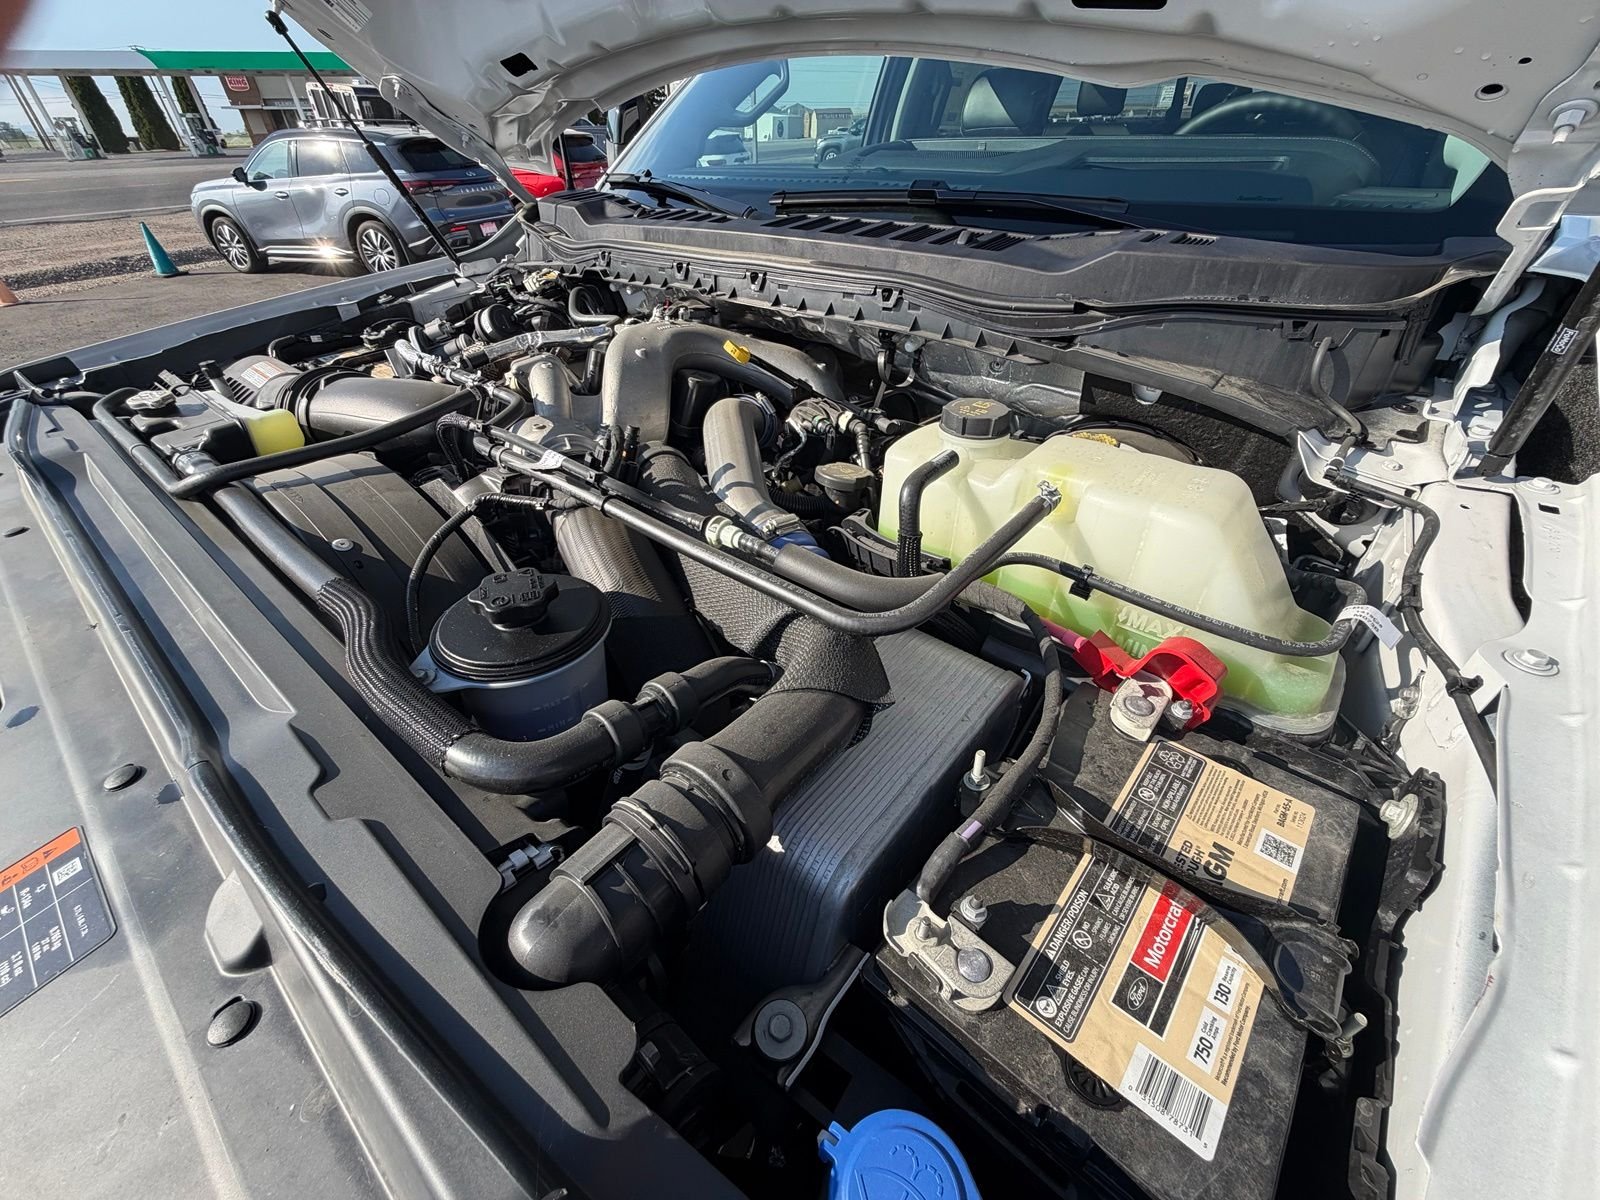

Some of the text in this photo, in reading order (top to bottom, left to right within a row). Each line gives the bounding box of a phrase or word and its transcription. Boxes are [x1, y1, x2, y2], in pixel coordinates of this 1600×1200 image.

[229, 77, 247, 86] KING
[1277, 798, 1292, 827] BAGM-65-A
[1103, 868, 1118, 891] SULFURIC
[1110, 882, 1120, 895] ACID
[1049, 889, 1088, 951] DANGER/POISON
[1081, 921, 1090, 930] NO
[1143, 898, 1183, 968] Motorcraf
[1054, 959, 1070, 981] SHIELD
[1054, 965, 1089, 1027] EXPLOSIVE GASES CAN
[1127, 981, 1146, 1006] Ford
[1212, 982, 1232, 1006] 130
[1062, 1014, 1075, 1033] CAUSE
[1070, 989, 1088, 1017] BLINDNESS
[1192, 1036, 1214, 1064] 750
